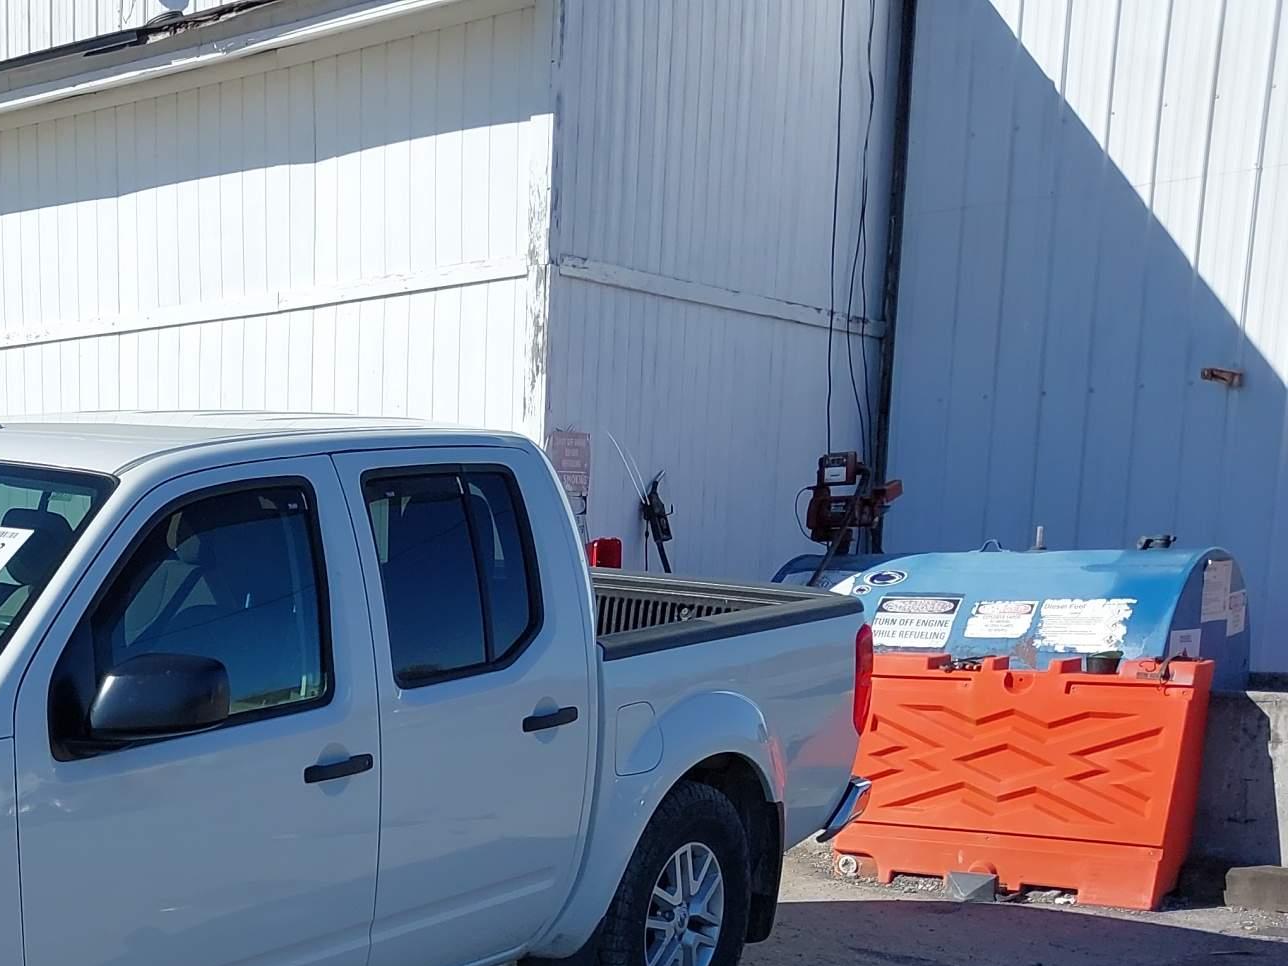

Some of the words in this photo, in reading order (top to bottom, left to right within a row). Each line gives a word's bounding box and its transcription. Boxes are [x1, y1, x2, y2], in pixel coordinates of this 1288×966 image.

[874, 617, 898, 626] TURN
[899, 618, 914, 627] OFF
[915, 619, 951, 628] ENGINE
[899, 630, 946, 640] REFUELING
